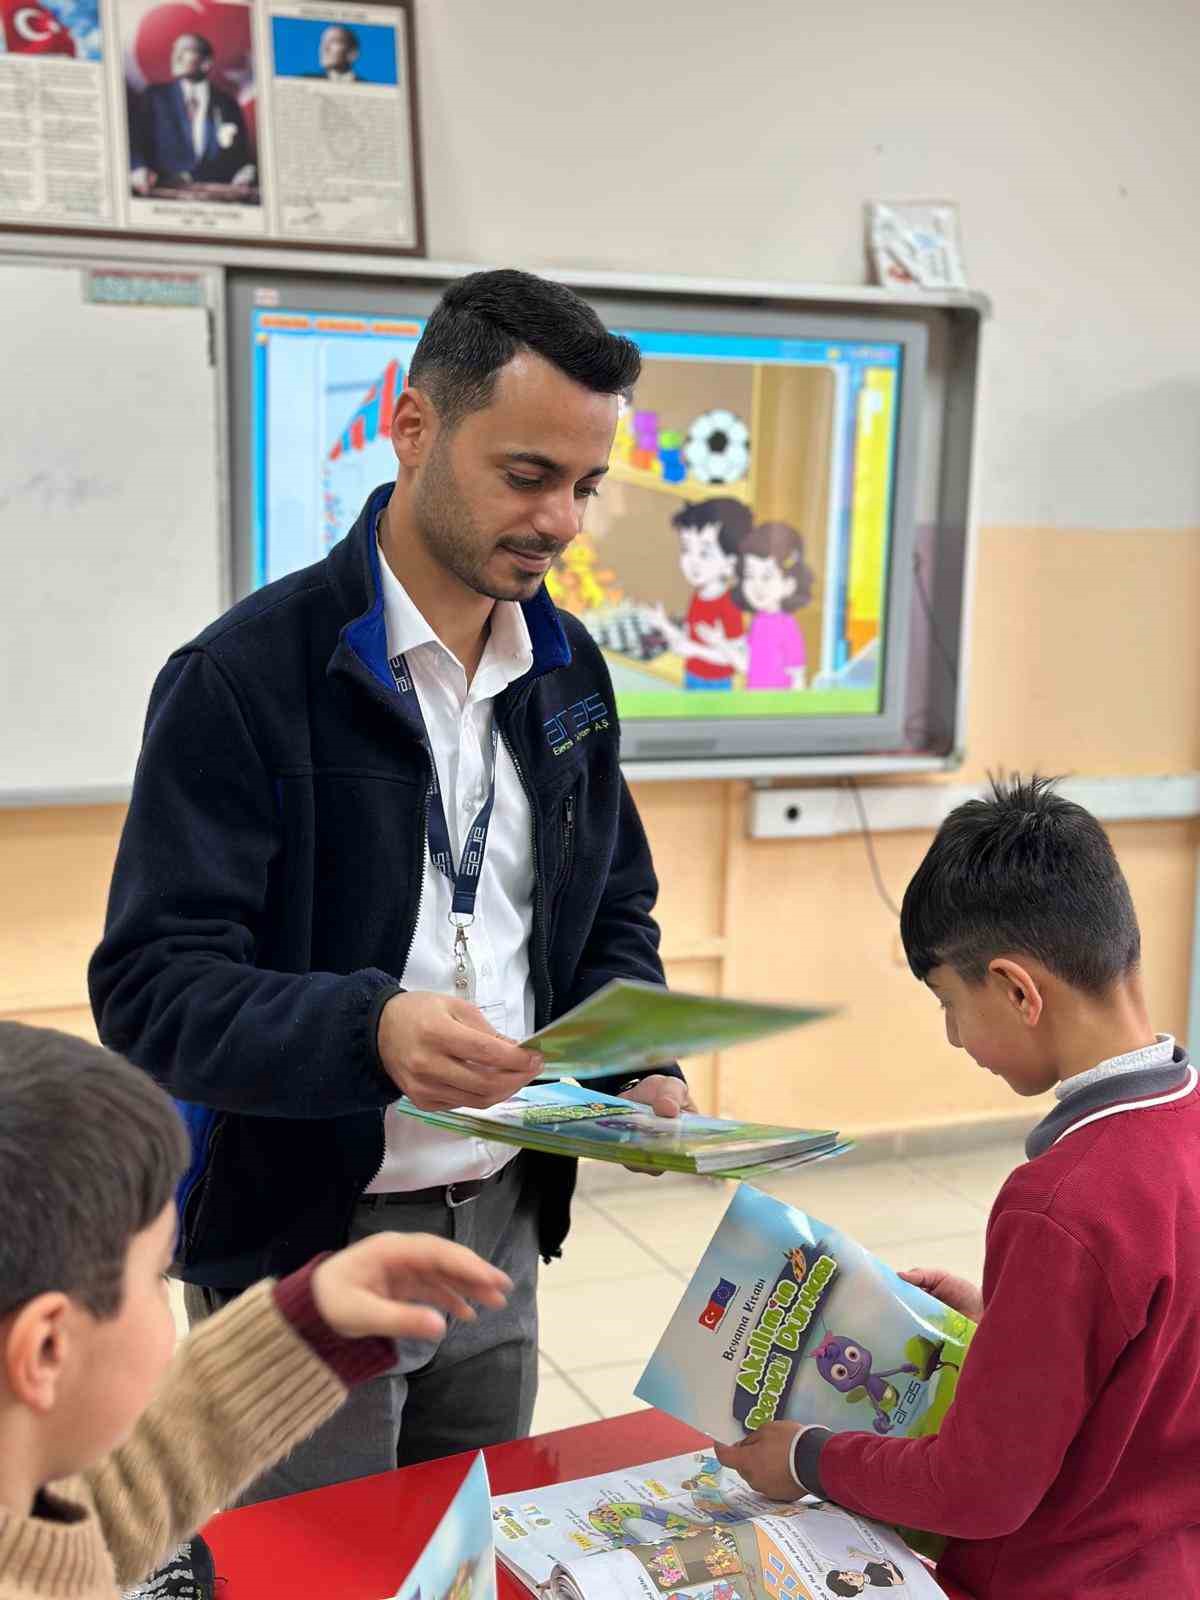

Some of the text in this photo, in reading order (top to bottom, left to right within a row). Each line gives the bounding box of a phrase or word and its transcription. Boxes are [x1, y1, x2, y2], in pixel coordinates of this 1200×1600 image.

[543, 692, 608, 746] aras
[465, 827, 486, 877] aras
[722, 1278, 766, 1362] Boyama Kitabı
[776, 1254, 838, 1352] Dünyası
[893, 1379, 922, 1425] aras
